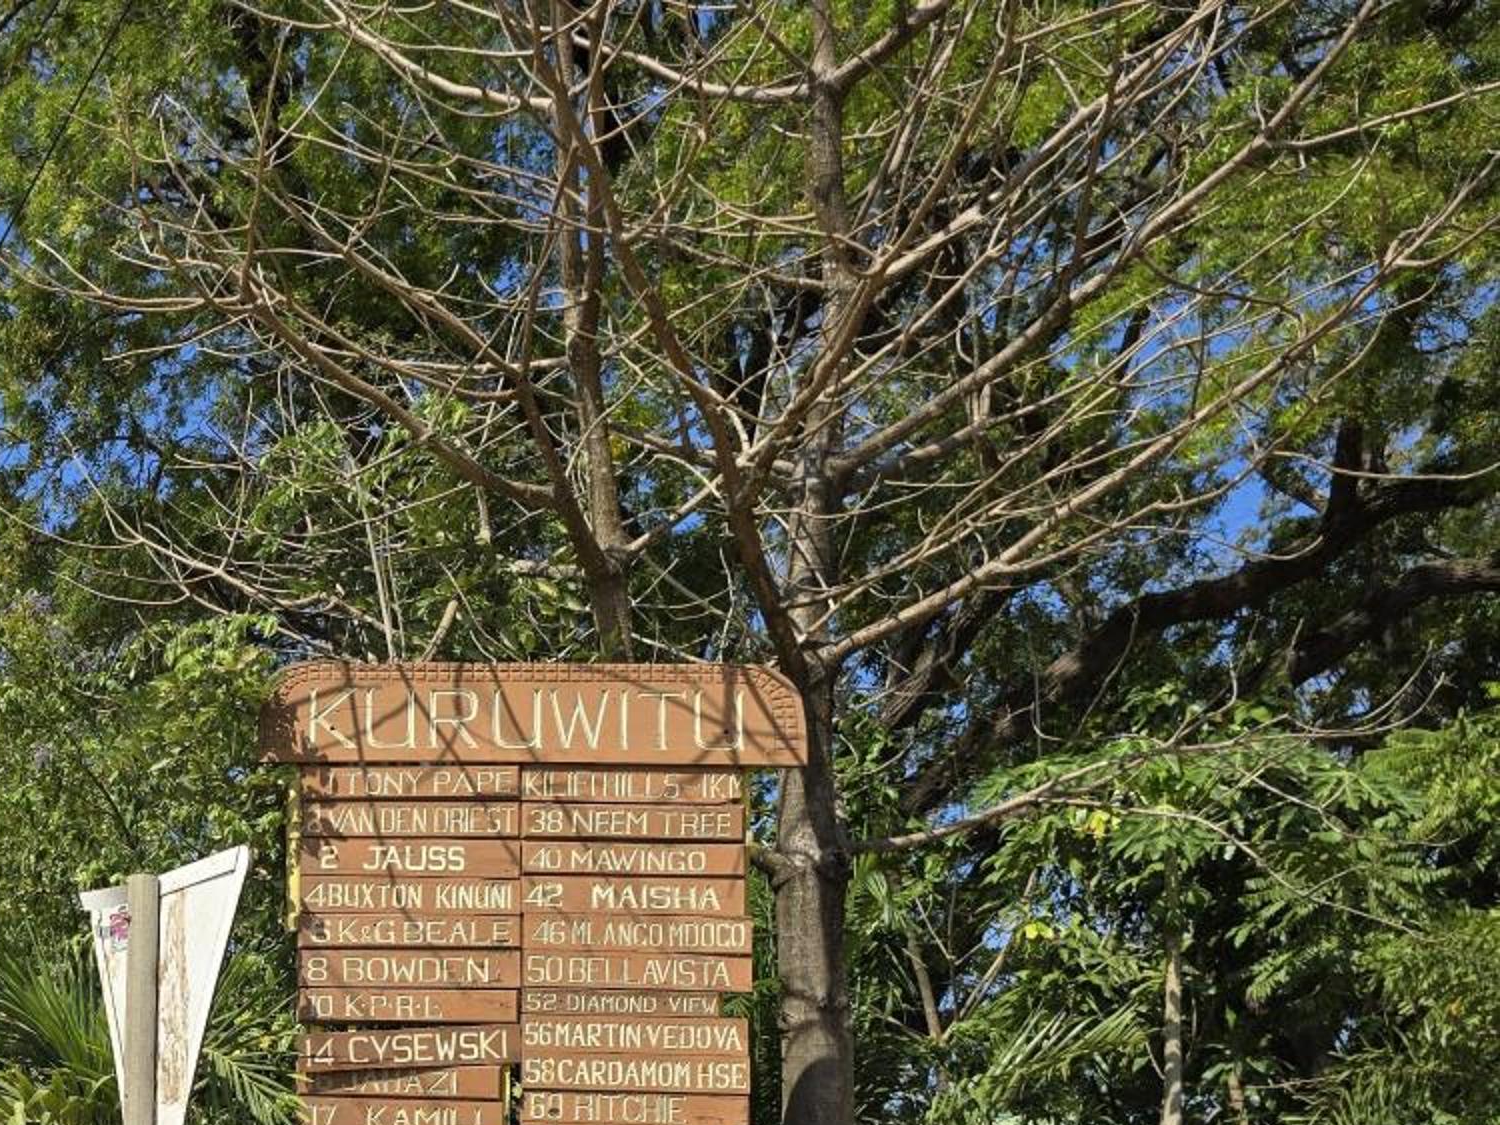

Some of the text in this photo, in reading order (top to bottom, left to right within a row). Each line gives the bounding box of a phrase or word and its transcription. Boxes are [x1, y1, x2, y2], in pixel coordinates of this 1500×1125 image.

[308, 687, 746, 751] KURUWITU
[343, 771, 423, 795] TONY
[433, 771, 513, 795] PAPE
[329, 807, 373, 833] VAN
[381, 807, 426, 833] DEN
[434, 807, 515, 833] DRIEST
[530, 810, 731, 836] 38 NEEM TREE
[321, 846, 466, 871] 2 JAUSS
[529, 849, 706, 871] 40 MAWINGO
[304, 883, 513, 909] 4 BUXTON KINUNI
[526, 883, 721, 910] 42 MAISHA
[403, 920, 513, 944] BEALE
[532, 920, 565, 944] 46
[307, 957, 489, 982] 8 BOWDEN
[527, 955, 563, 984] 50
[526, 993, 717, 1015] 52 DIAMOND VIEW
[525, 1023, 551, 1047] 56
[305, 1031, 508, 1067] 14 CYSEWSKI
[525, 1057, 747, 1090] 58 CARDAMOM HSE
[530, 1093, 563, 1119] 60
